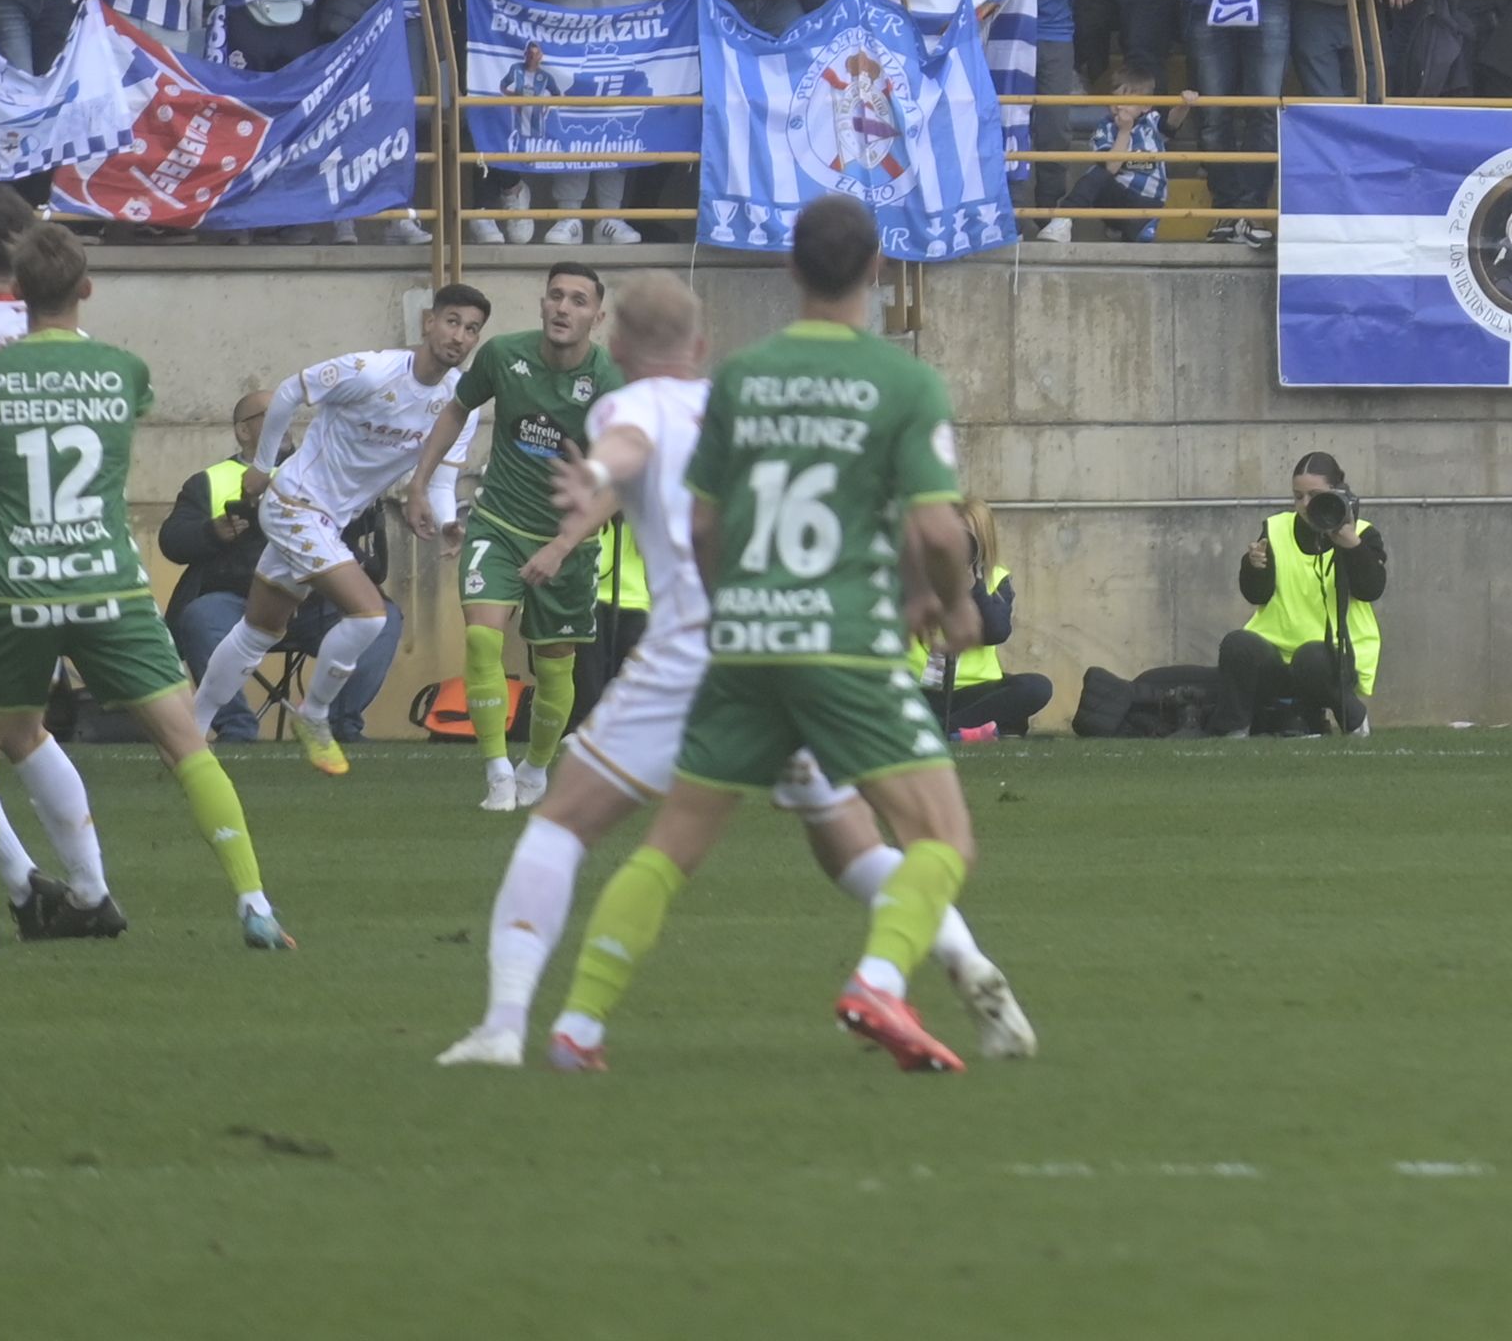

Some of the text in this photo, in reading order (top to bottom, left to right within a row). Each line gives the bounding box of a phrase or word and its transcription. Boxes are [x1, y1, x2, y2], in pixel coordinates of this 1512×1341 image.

[491, 14, 669, 45] BRANQUIAZUL
[320, 128, 409, 205] TURCO
[1449, 243, 1465, 269] LOS
[1453, 268, 1485, 317] VIENTOS
[1484, 310, 1504, 333] DEL
[741, 375, 880, 412] PELICANO
[520, 419, 561, 441] Estrella
[520, 431, 558, 450] Galicia
[14, 423, 104, 526] 12
[739, 459, 843, 580] 16
[7, 548, 118, 582] DIGI
[467, 539, 492, 571] 7
[10, 597, 122, 630] DIGI
[709, 620, 832, 653] DIGI
